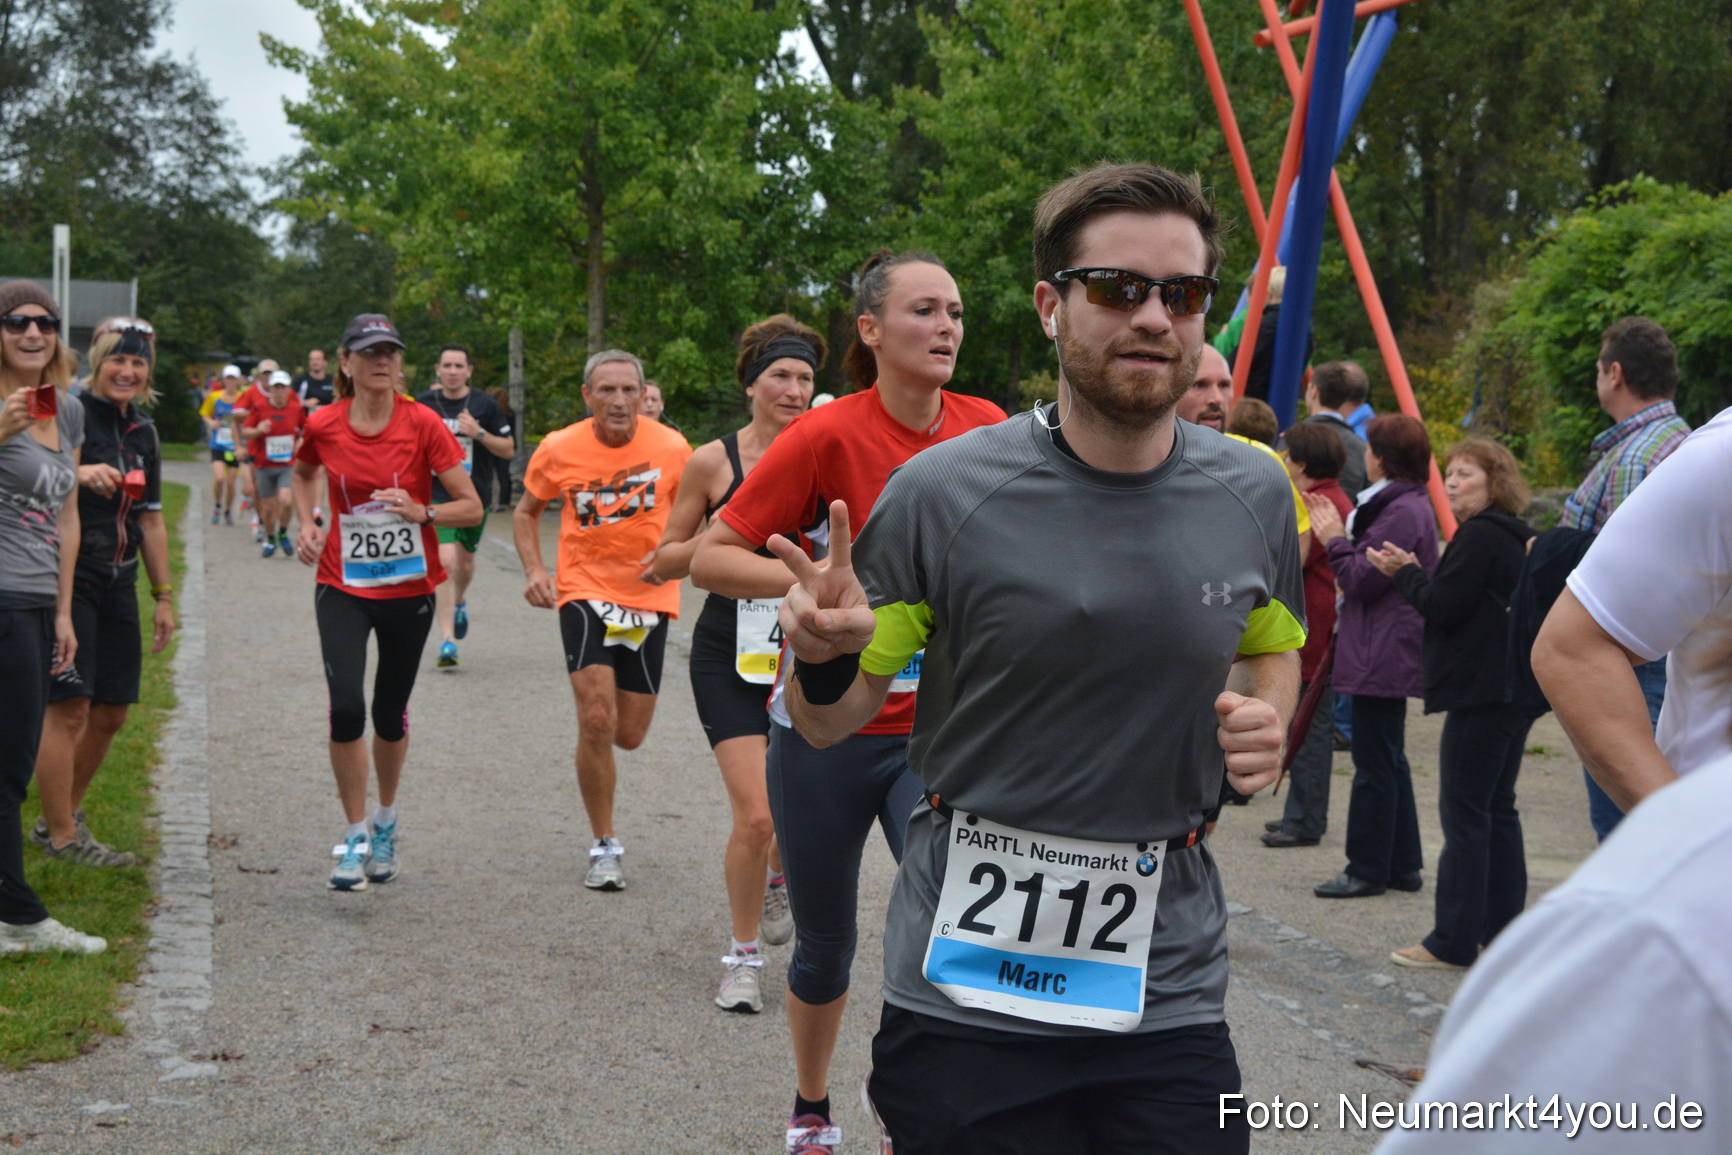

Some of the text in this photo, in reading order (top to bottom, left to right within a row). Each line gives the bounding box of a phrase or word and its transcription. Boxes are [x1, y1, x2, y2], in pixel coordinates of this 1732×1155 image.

[350, 528, 414, 559] 2623
[740, 604, 772, 613] PARTL
[768, 619, 784, 649] 4
[956, 827, 1129, 873] PARTL Neumarkt
[957, 862, 1138, 954] 2112
[998, 961, 1068, 996] Marc
